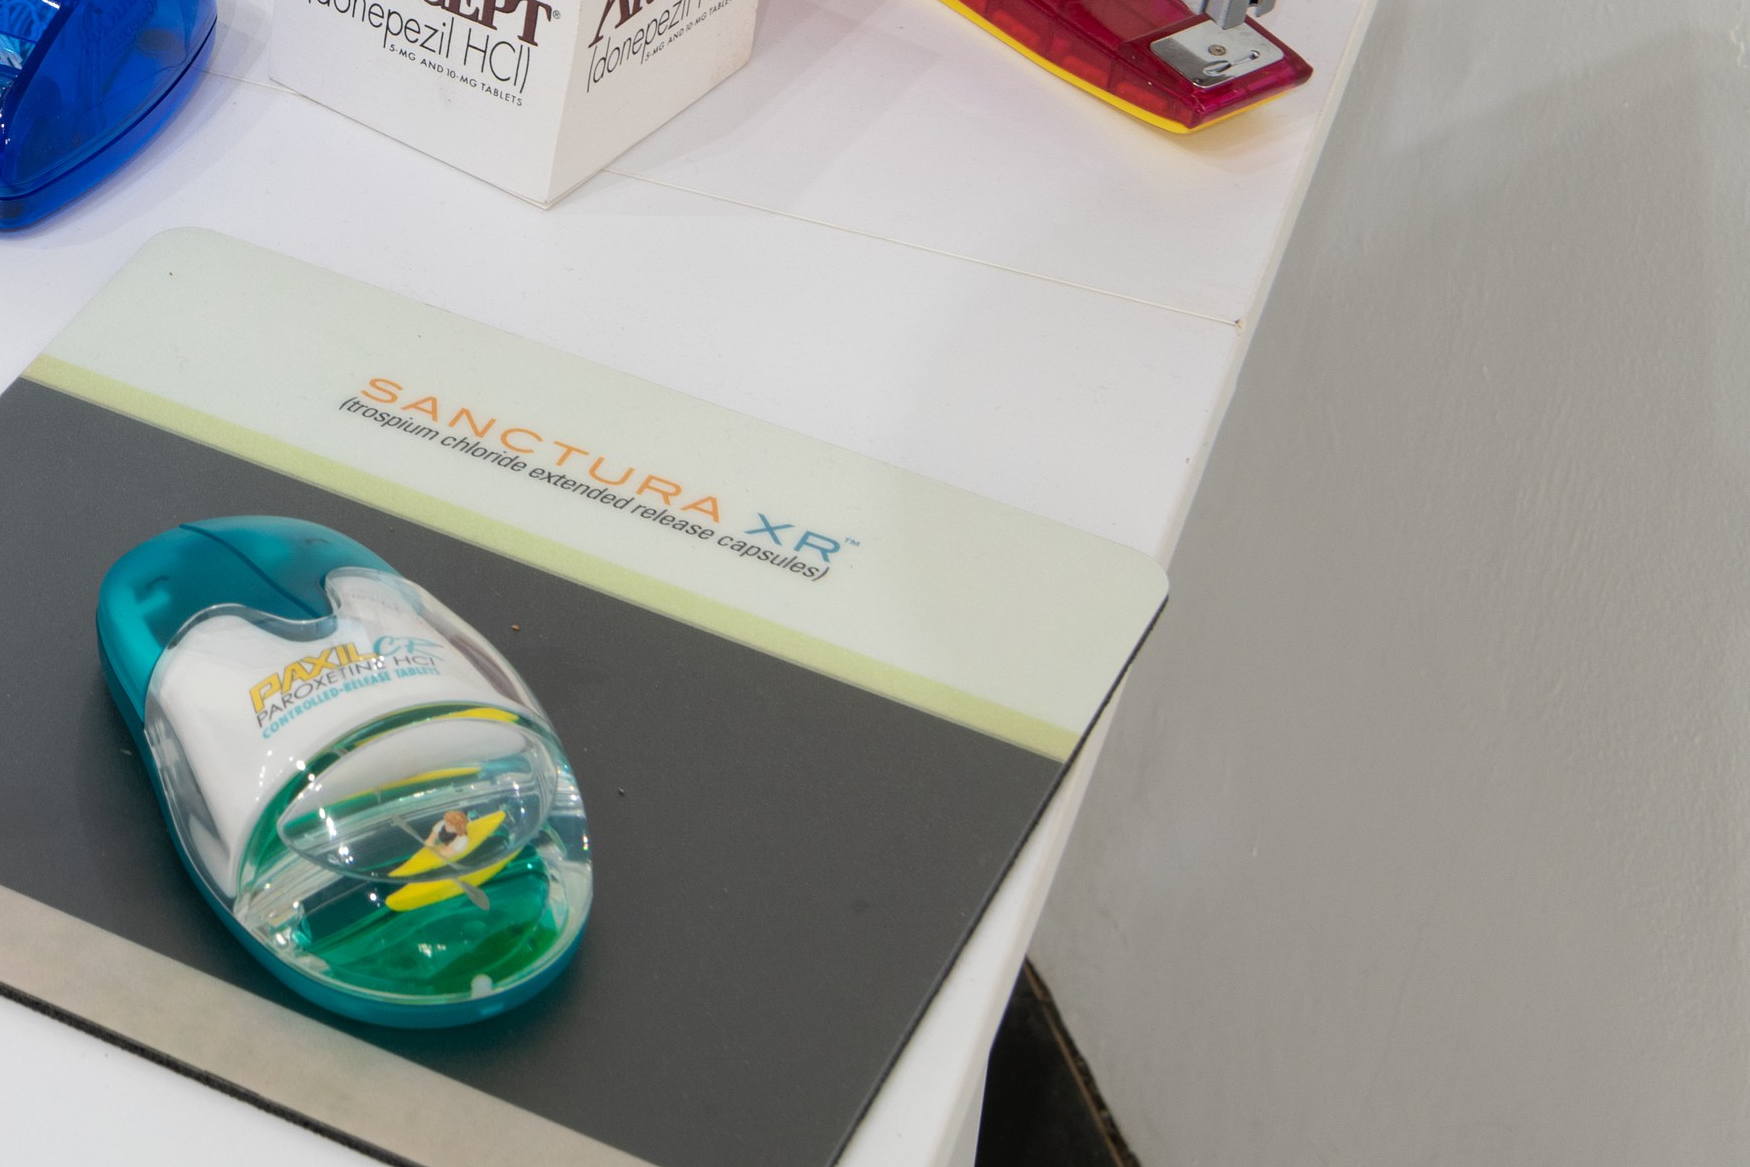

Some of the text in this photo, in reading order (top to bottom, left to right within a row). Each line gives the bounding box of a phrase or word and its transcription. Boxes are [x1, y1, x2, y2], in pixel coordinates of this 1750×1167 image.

[389, 43, 523, 107] 5-MG AND 10-MG TABLETS
[339, 396, 830, 583] (trospium chloride extended release capsules)
[360, 377, 721, 524] SANCTURA
[249, 641, 382, 714] PAXIL
